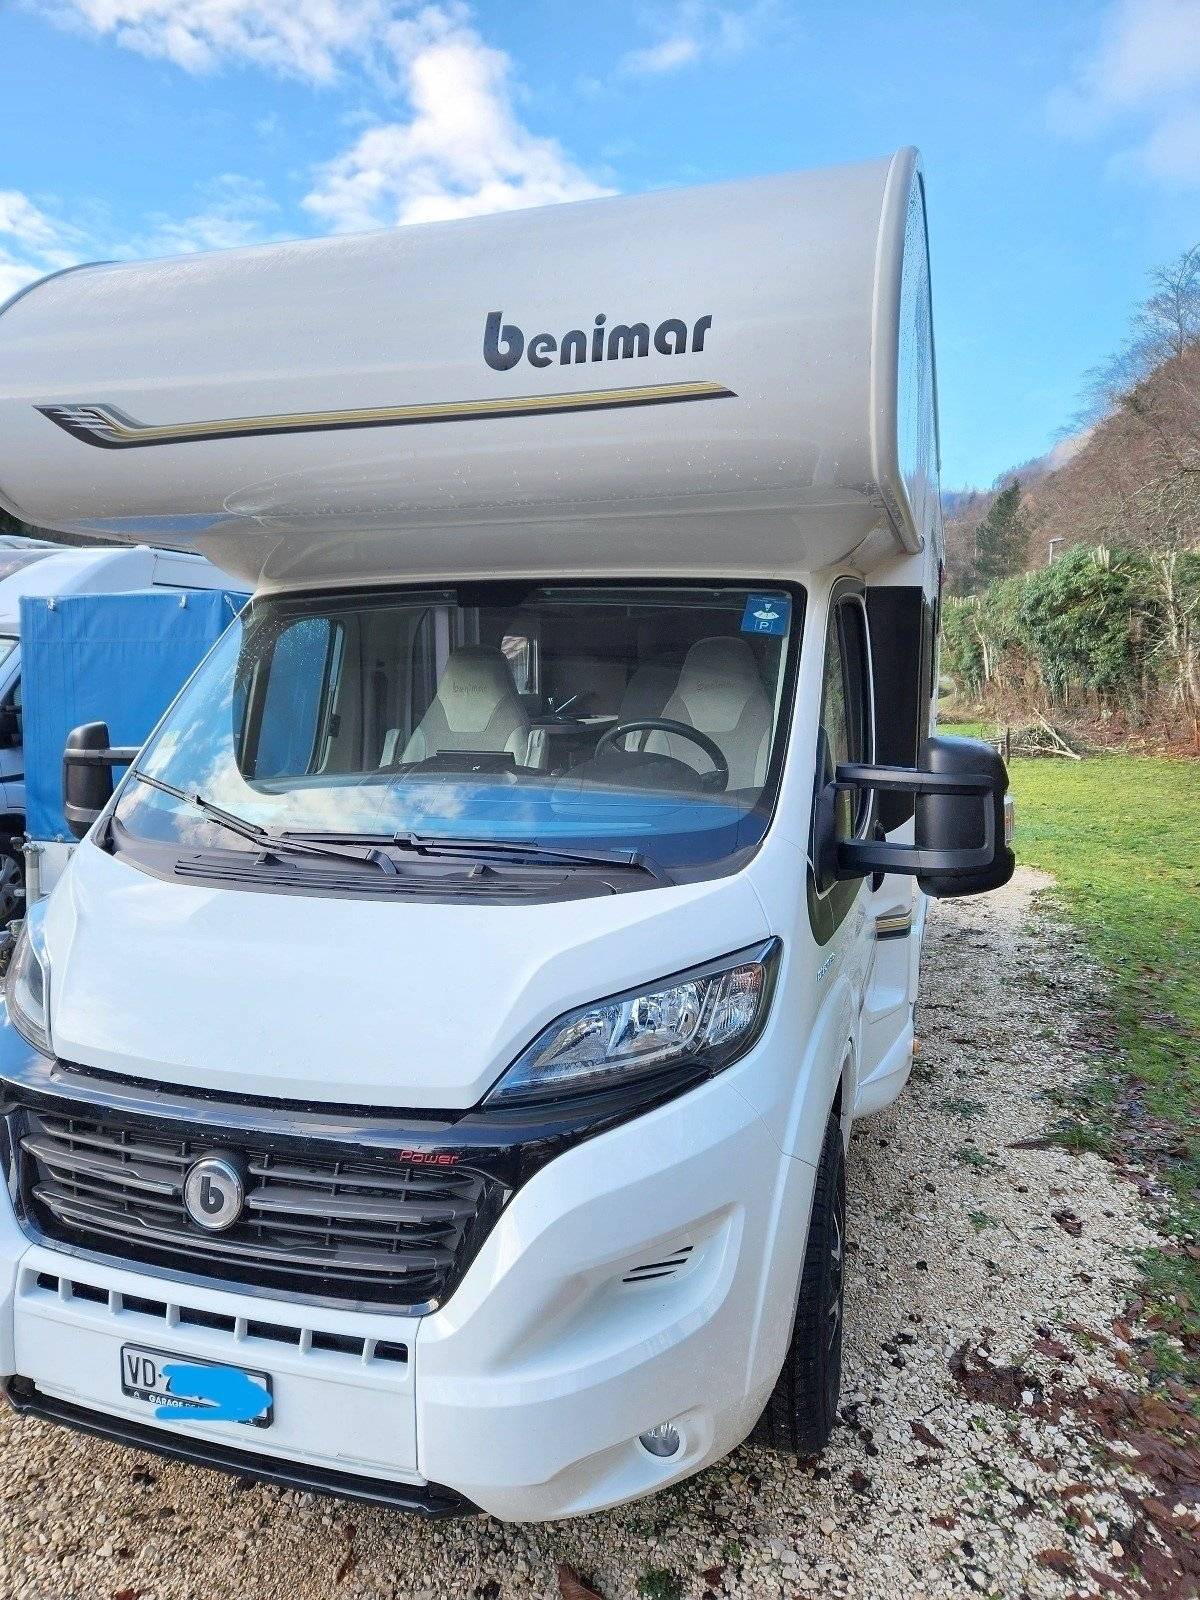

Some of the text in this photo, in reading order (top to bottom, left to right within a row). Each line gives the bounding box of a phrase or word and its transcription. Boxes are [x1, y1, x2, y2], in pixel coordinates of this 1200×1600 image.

[483, 311, 713, 372] benimar
[759, 621, 769, 630] P
[400, 1150, 459, 1165] Power
[200, 1176, 225, 1215] b
[127, 1354, 156, 1388] VD
[149, 1395, 184, 1409] GARAGE
